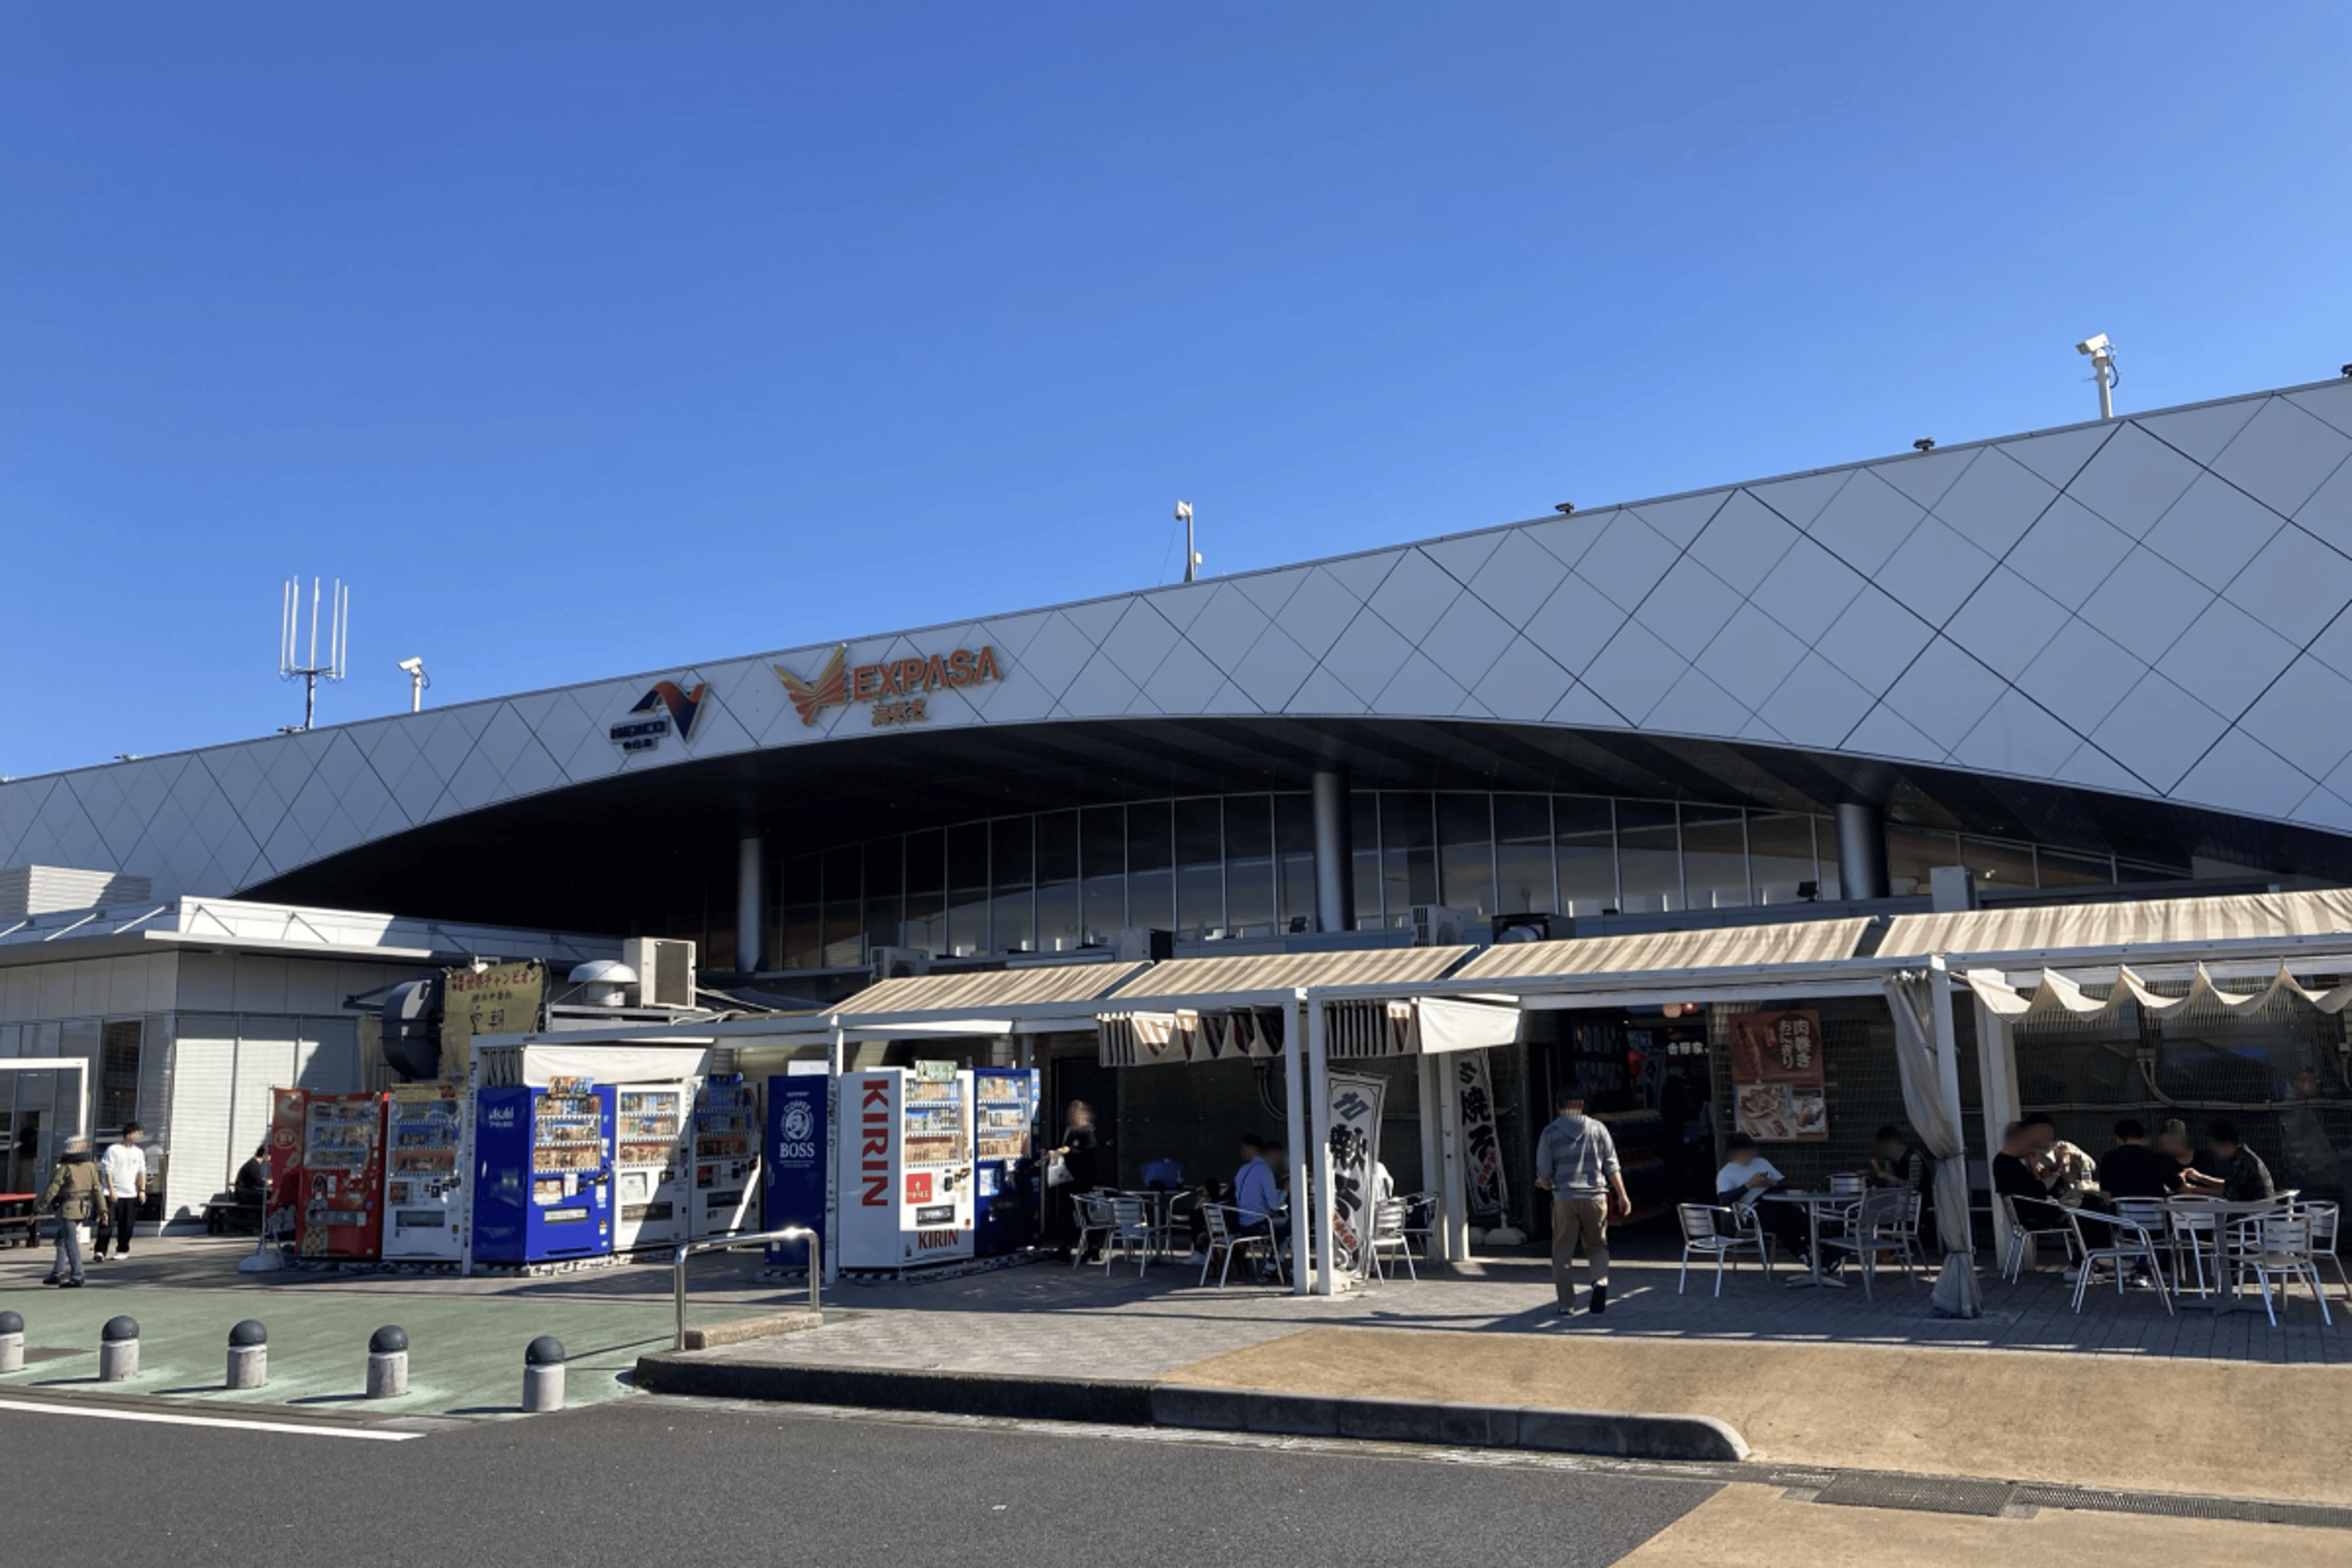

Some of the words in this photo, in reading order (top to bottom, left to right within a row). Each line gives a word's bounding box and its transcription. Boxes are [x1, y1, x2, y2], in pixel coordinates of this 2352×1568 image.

[853, 646, 1000, 700] EXPASA
[779, 1142, 815, 1159] BOSS
[862, 1079, 889, 1206] KIRIN
[919, 1229, 959, 1250] KIRIN
